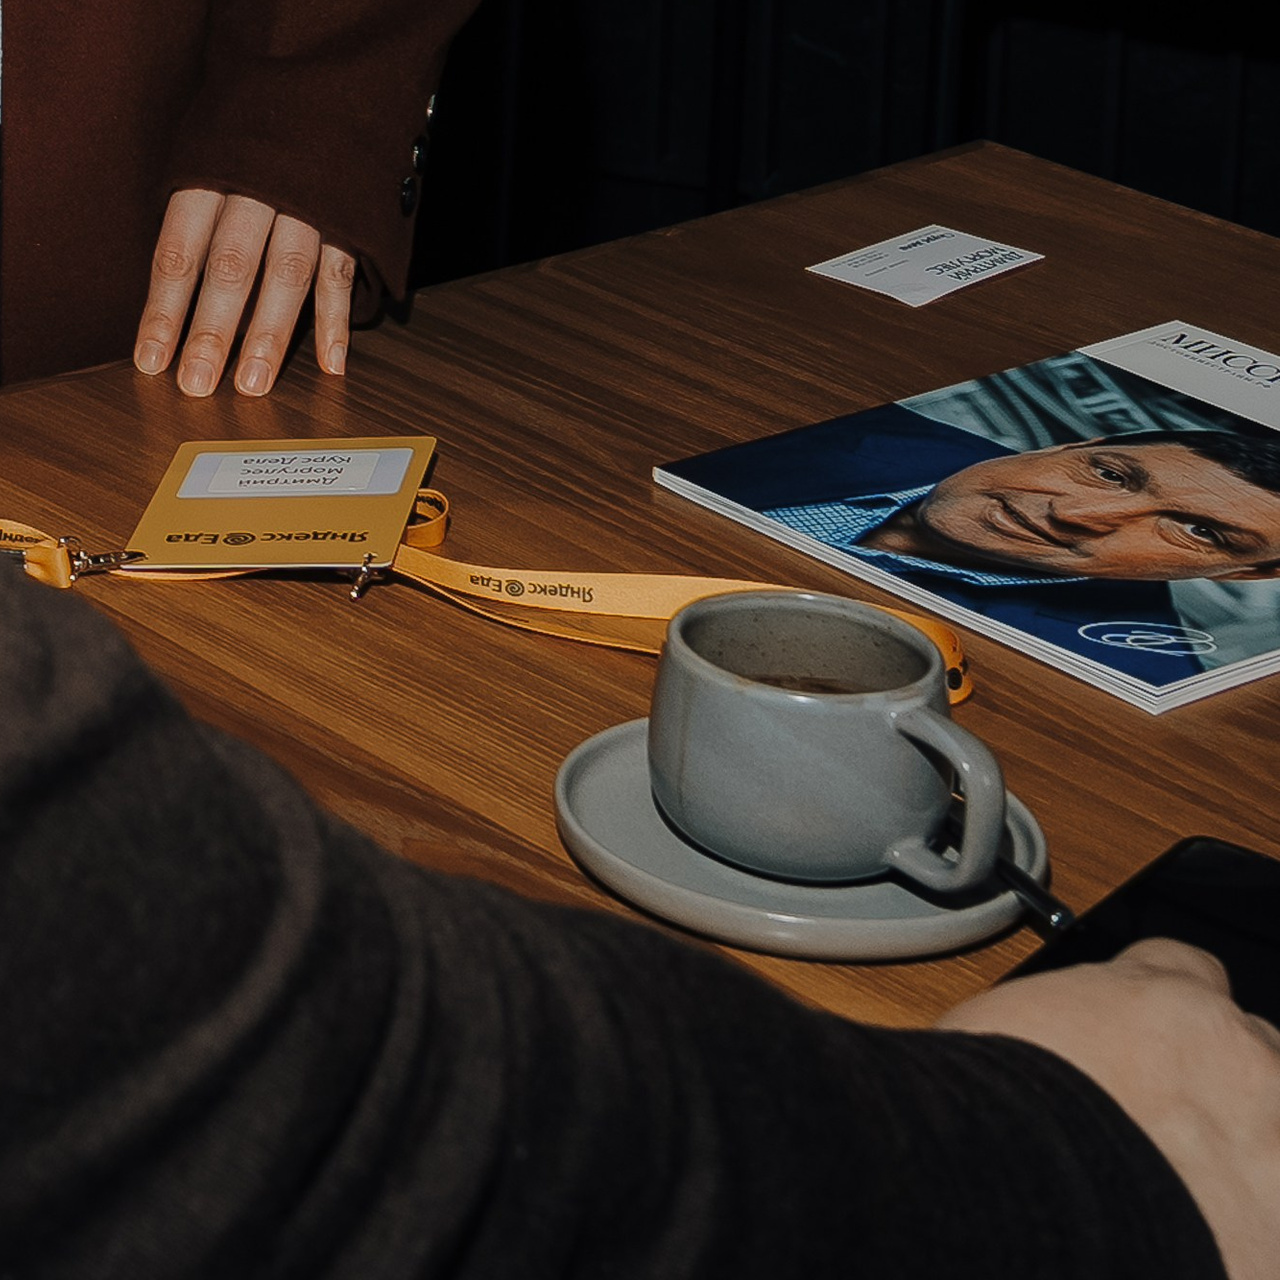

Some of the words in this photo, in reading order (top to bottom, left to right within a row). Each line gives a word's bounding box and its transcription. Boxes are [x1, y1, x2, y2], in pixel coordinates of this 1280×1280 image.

[243, 456, 296, 466] Дела
[297, 455, 351, 465] Курс
[240, 466, 344, 476] Моргулес
[238, 476, 338, 487] Дмитрий
[166, 532, 220, 545] Еда
[260, 531, 370, 544] Яндекс
[470, 574, 503, 593] Еда
[528, 582, 594, 603] Яндекс
